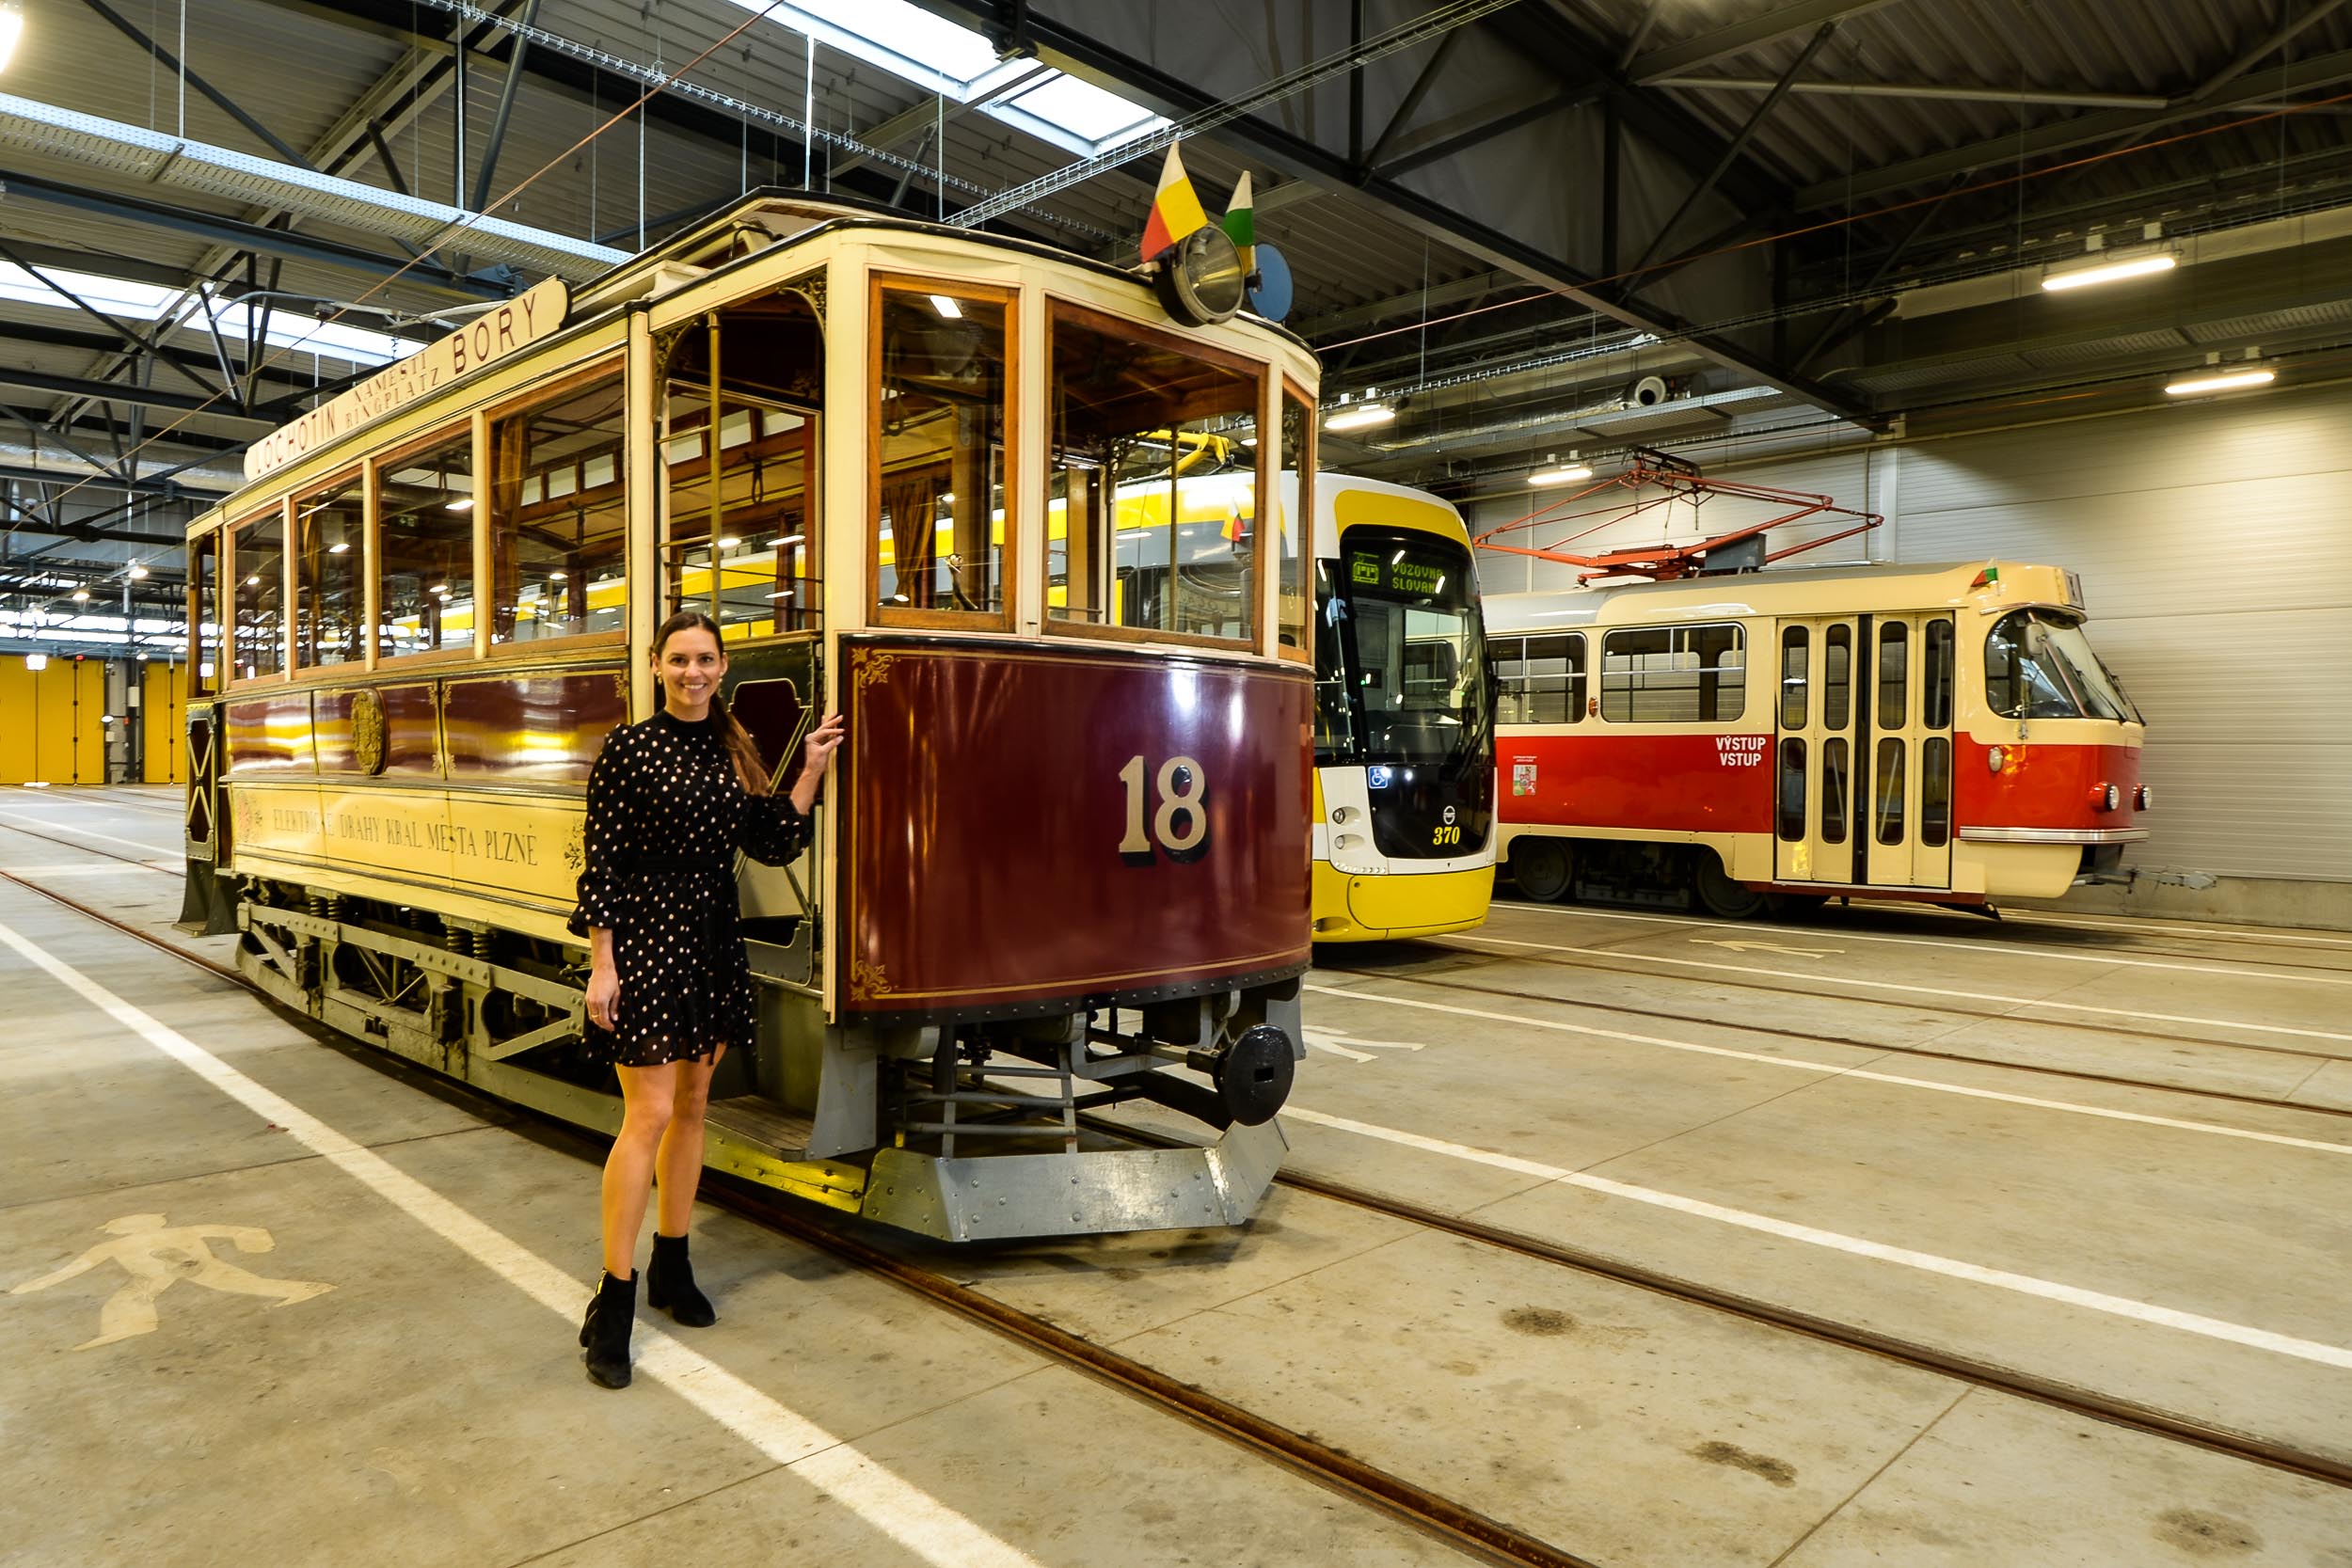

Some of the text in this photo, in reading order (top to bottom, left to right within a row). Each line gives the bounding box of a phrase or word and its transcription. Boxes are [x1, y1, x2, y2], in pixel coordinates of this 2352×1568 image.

[453, 293, 535, 374] BORY
[345, 367, 439, 429] RINGPLATZ
[1392, 577, 1444, 594] SLOVAN
[1715, 735, 1767, 751] VÝSTUP
[1719, 752, 1762, 767] VSTUP
[1118, 754, 1208, 854] 18
[1433, 826, 1460, 846] 370
